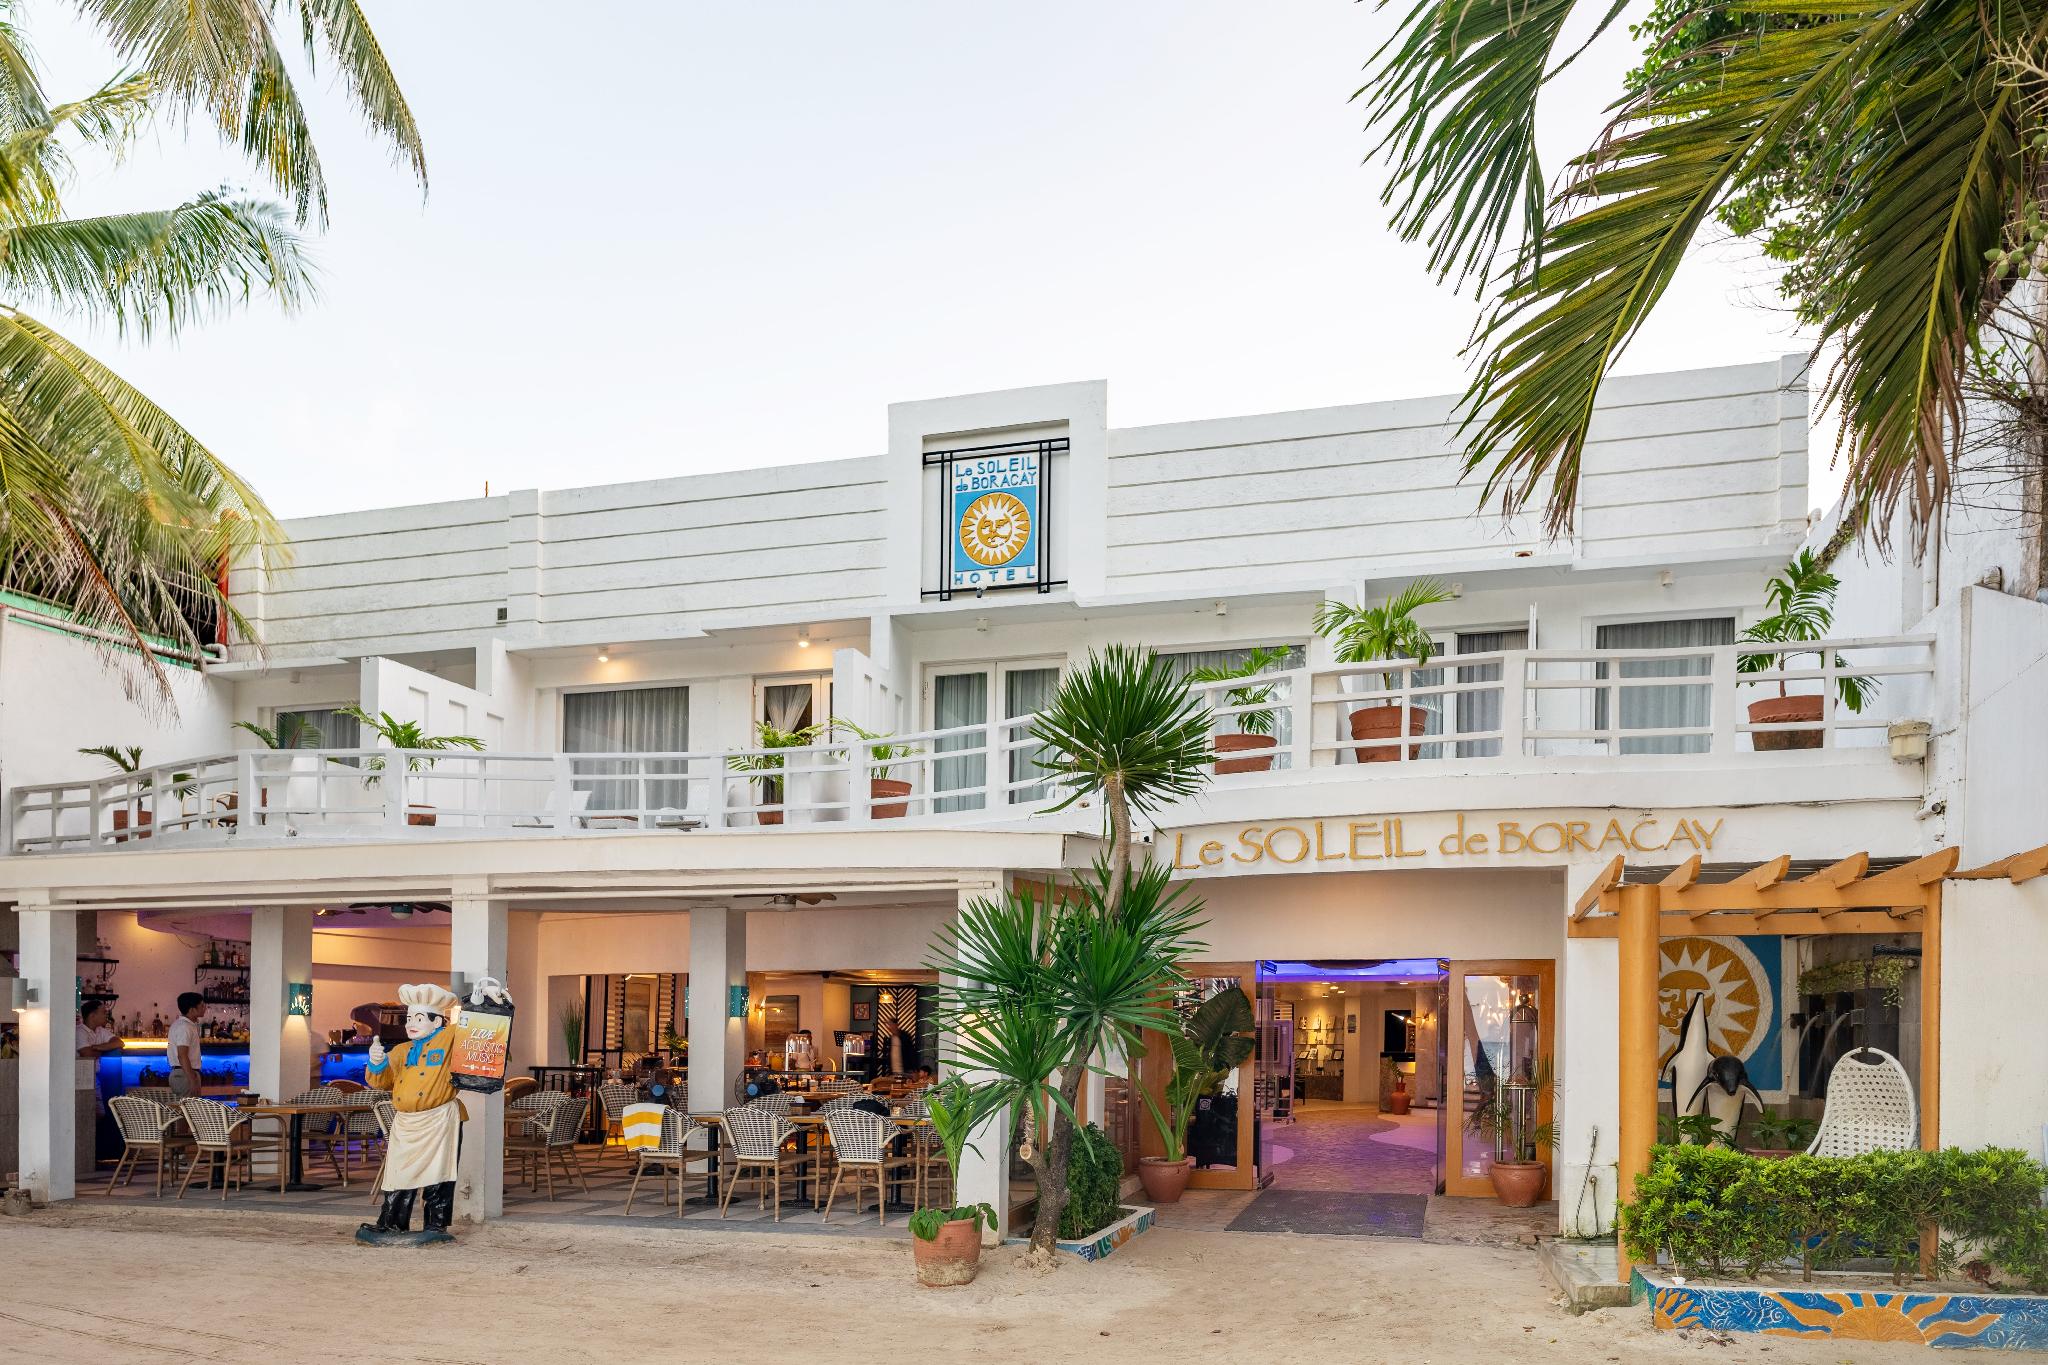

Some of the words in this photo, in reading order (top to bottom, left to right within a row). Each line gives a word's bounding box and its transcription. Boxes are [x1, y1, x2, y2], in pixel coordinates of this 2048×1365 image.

[955, 463, 973, 478] Le
[977, 456, 1037, 475] SOLEIL
[955, 477, 969, 492] de
[971, 472, 1037, 490] BORACAY
[954, 567, 1036, 585] HOTEL
[1174, 832, 1224, 870] Le
[1231, 818, 1427, 864] SOLEIL
[1438, 812, 1489, 855] de
[1496, 818, 1724, 855] BORACAY
[471, 1027, 496, 1040] LIVE
[460, 1039, 505, 1054] ACOUSTIC
[465, 1051, 495, 1064] MUSIC
